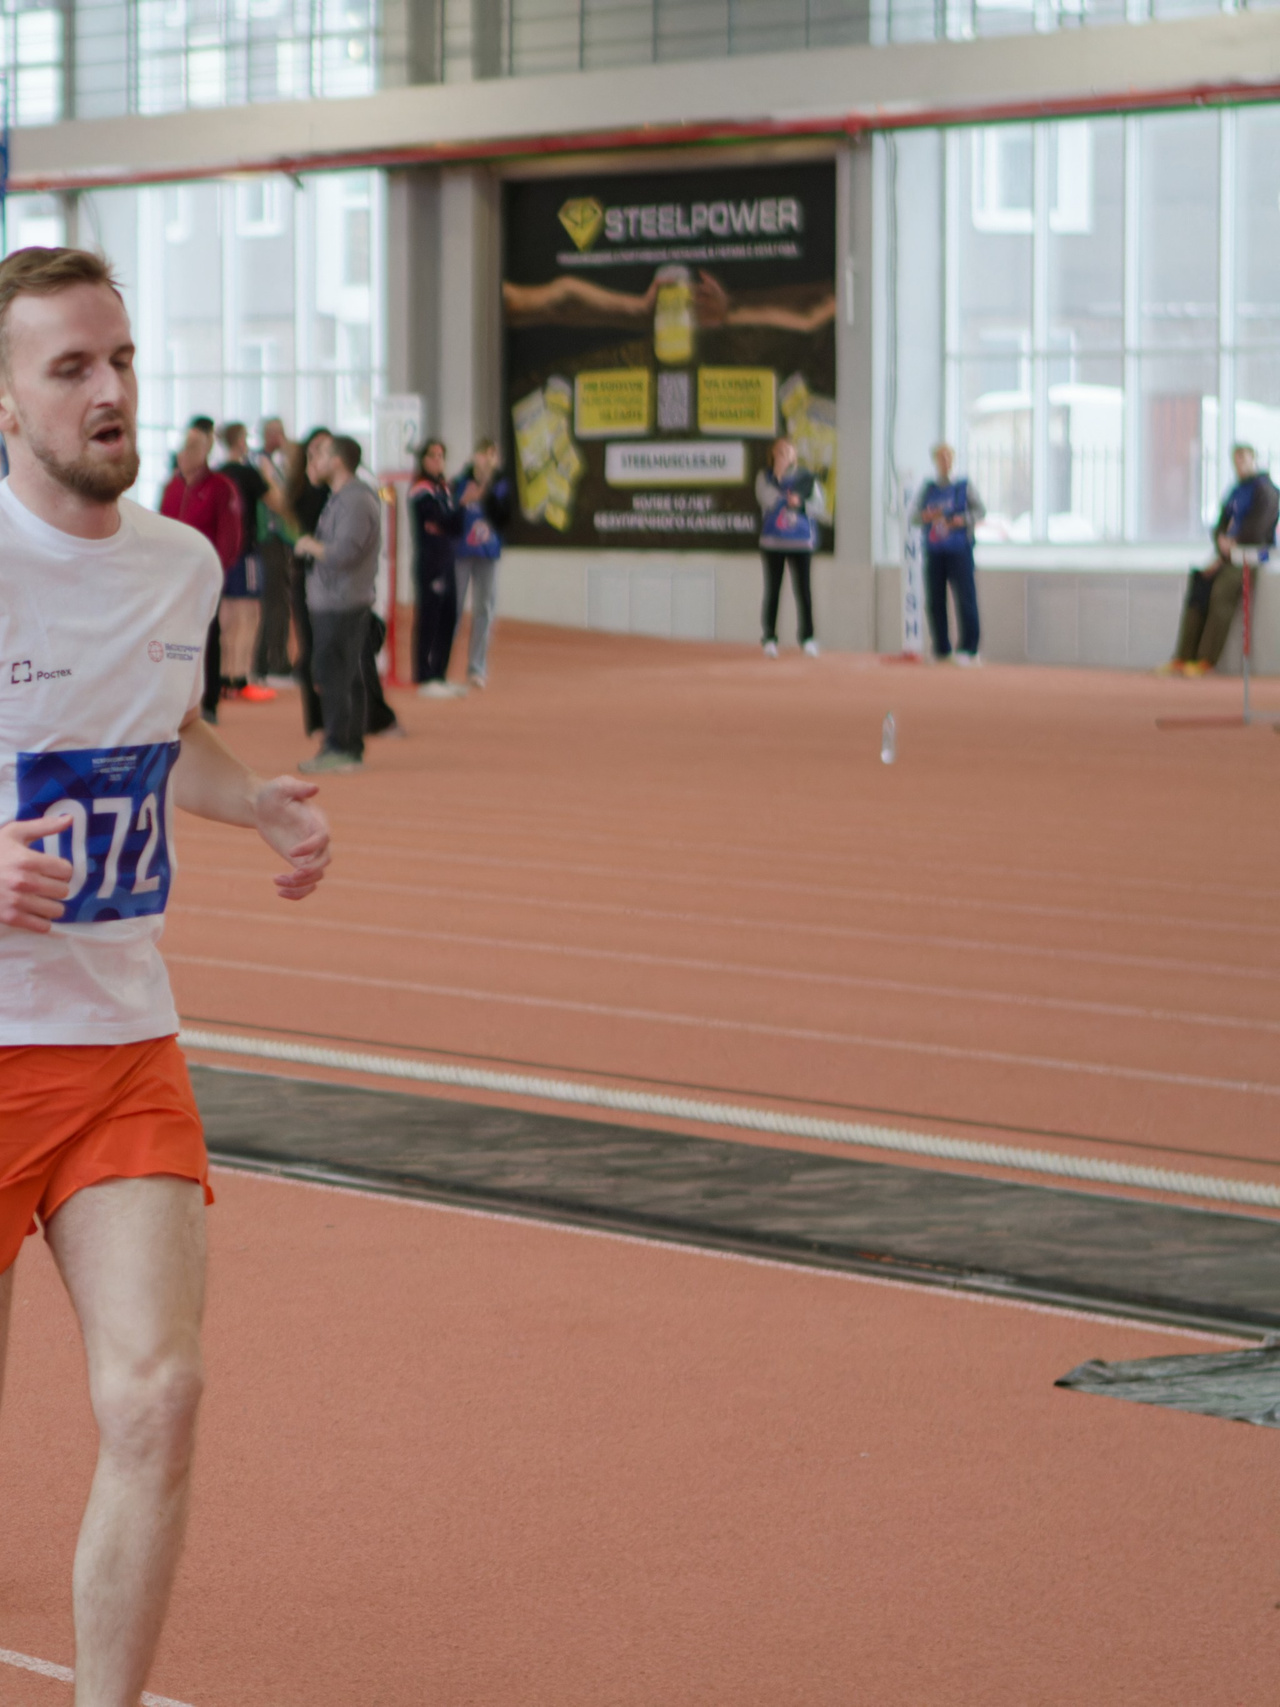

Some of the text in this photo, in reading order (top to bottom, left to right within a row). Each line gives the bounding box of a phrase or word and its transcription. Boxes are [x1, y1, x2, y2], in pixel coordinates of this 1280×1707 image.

[604, 197, 798, 240] STEELPOWER
[36, 668, 72, 681] Ростех
[42, 792, 161, 901] 072
